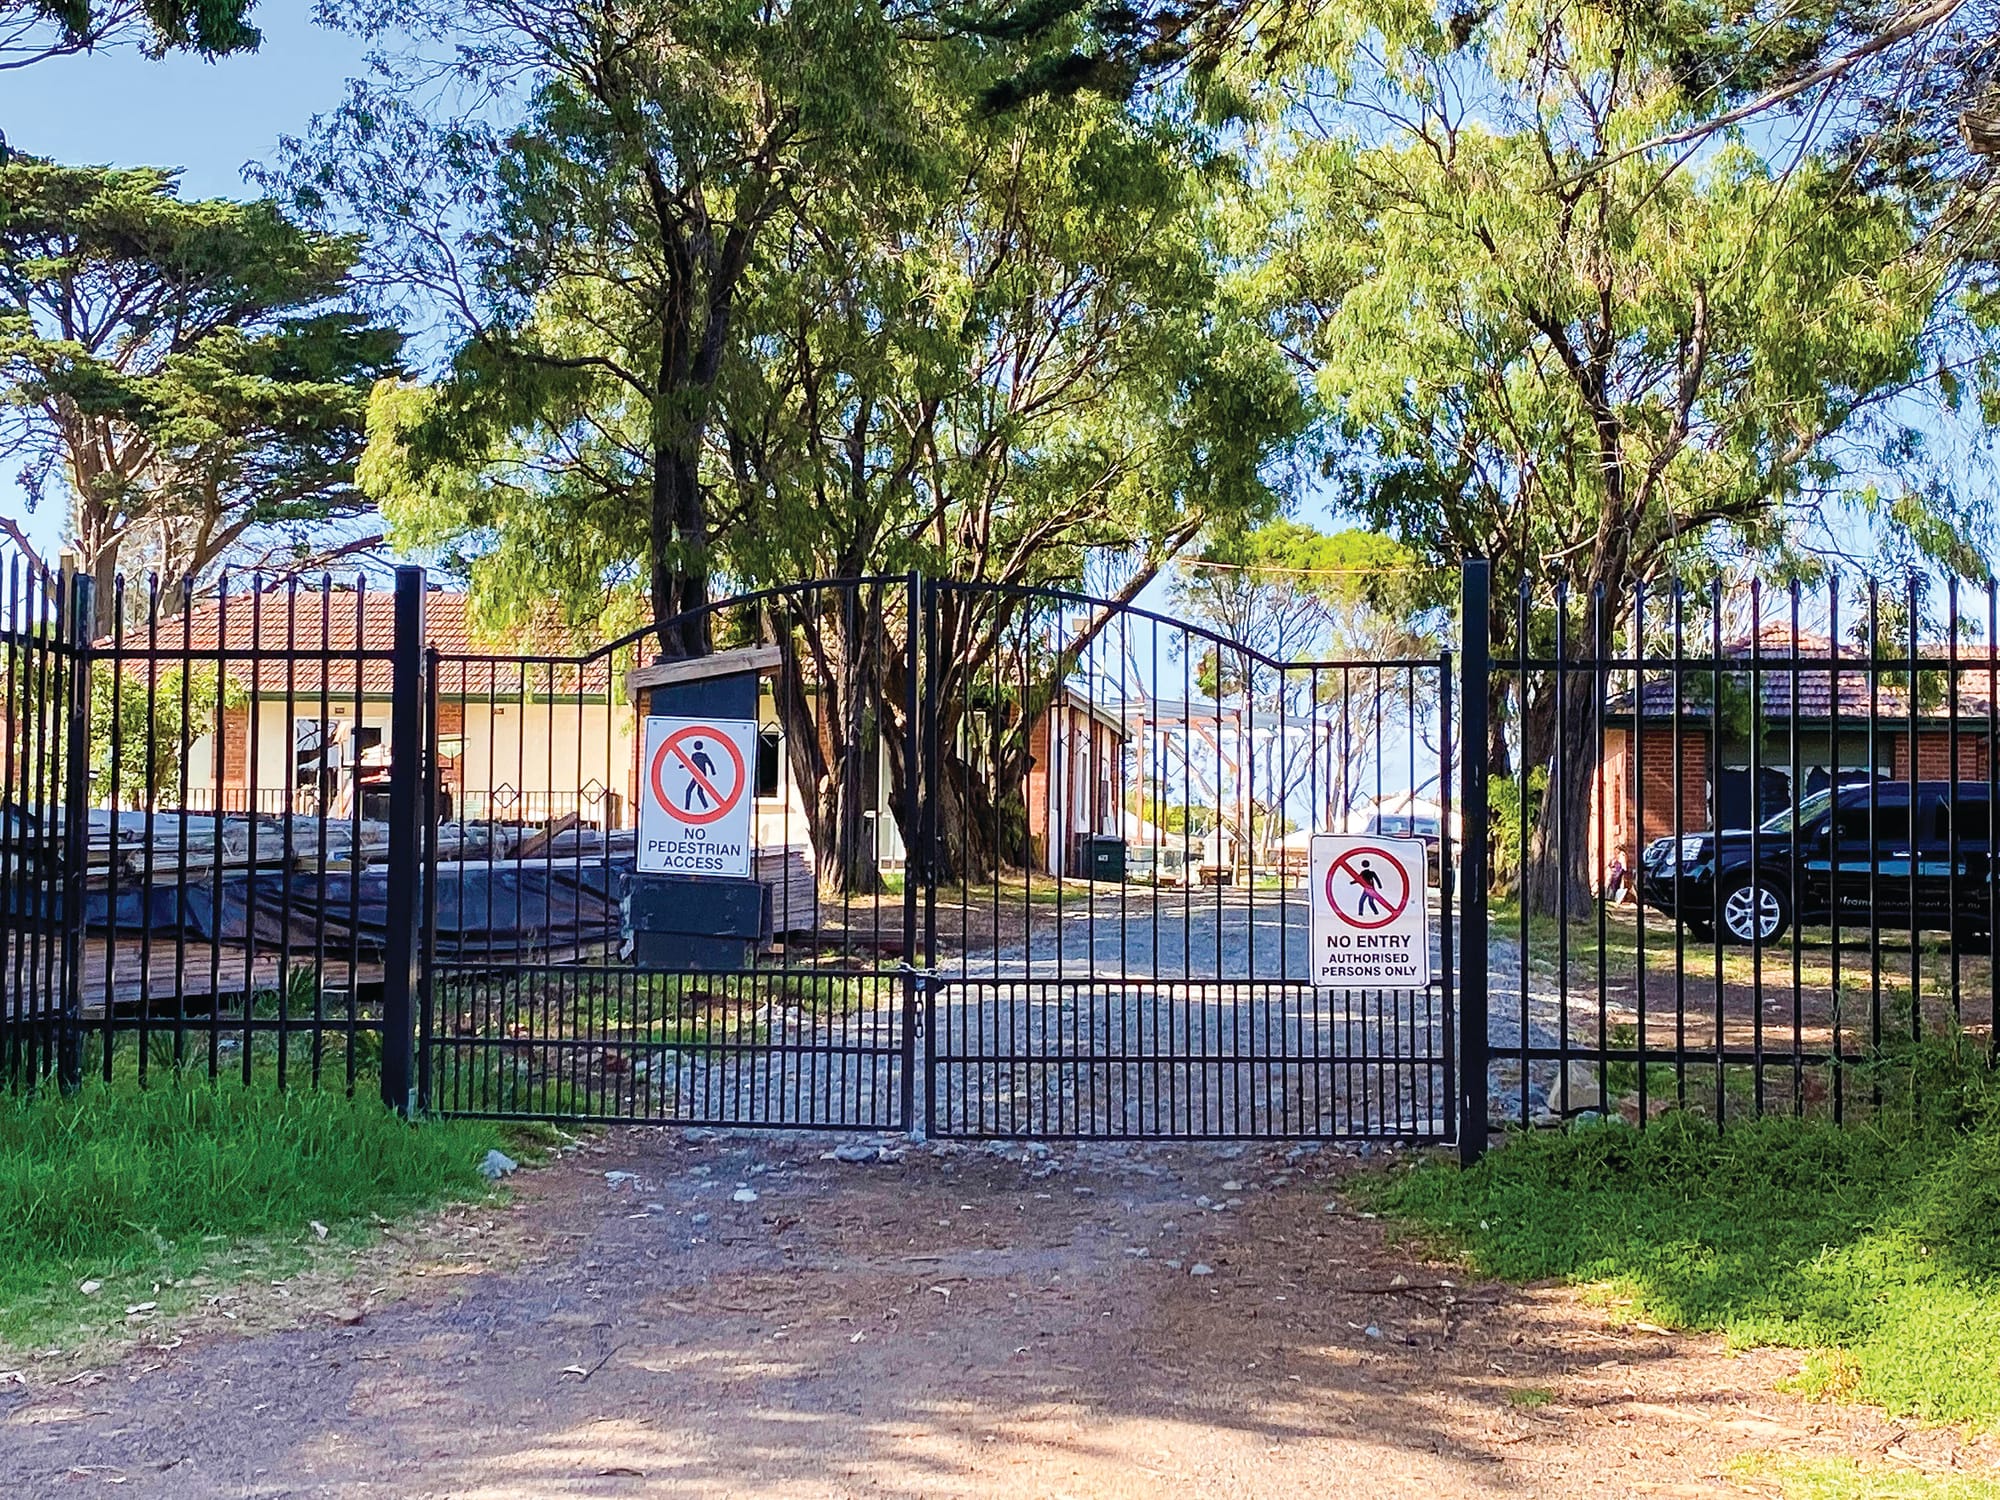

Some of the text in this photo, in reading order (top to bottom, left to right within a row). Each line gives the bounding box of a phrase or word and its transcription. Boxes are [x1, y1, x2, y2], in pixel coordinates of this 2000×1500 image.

[684, 828, 706, 840] NO
[648, 840, 741, 856] PEDESTRIAN
[663, 855, 723, 870] ACCESS
[1327, 935, 1411, 948] NO ENTRY
[1329, 953, 1409, 964] AUTHORISED
[1322, 966, 1417, 977] PERSONS ONLY
